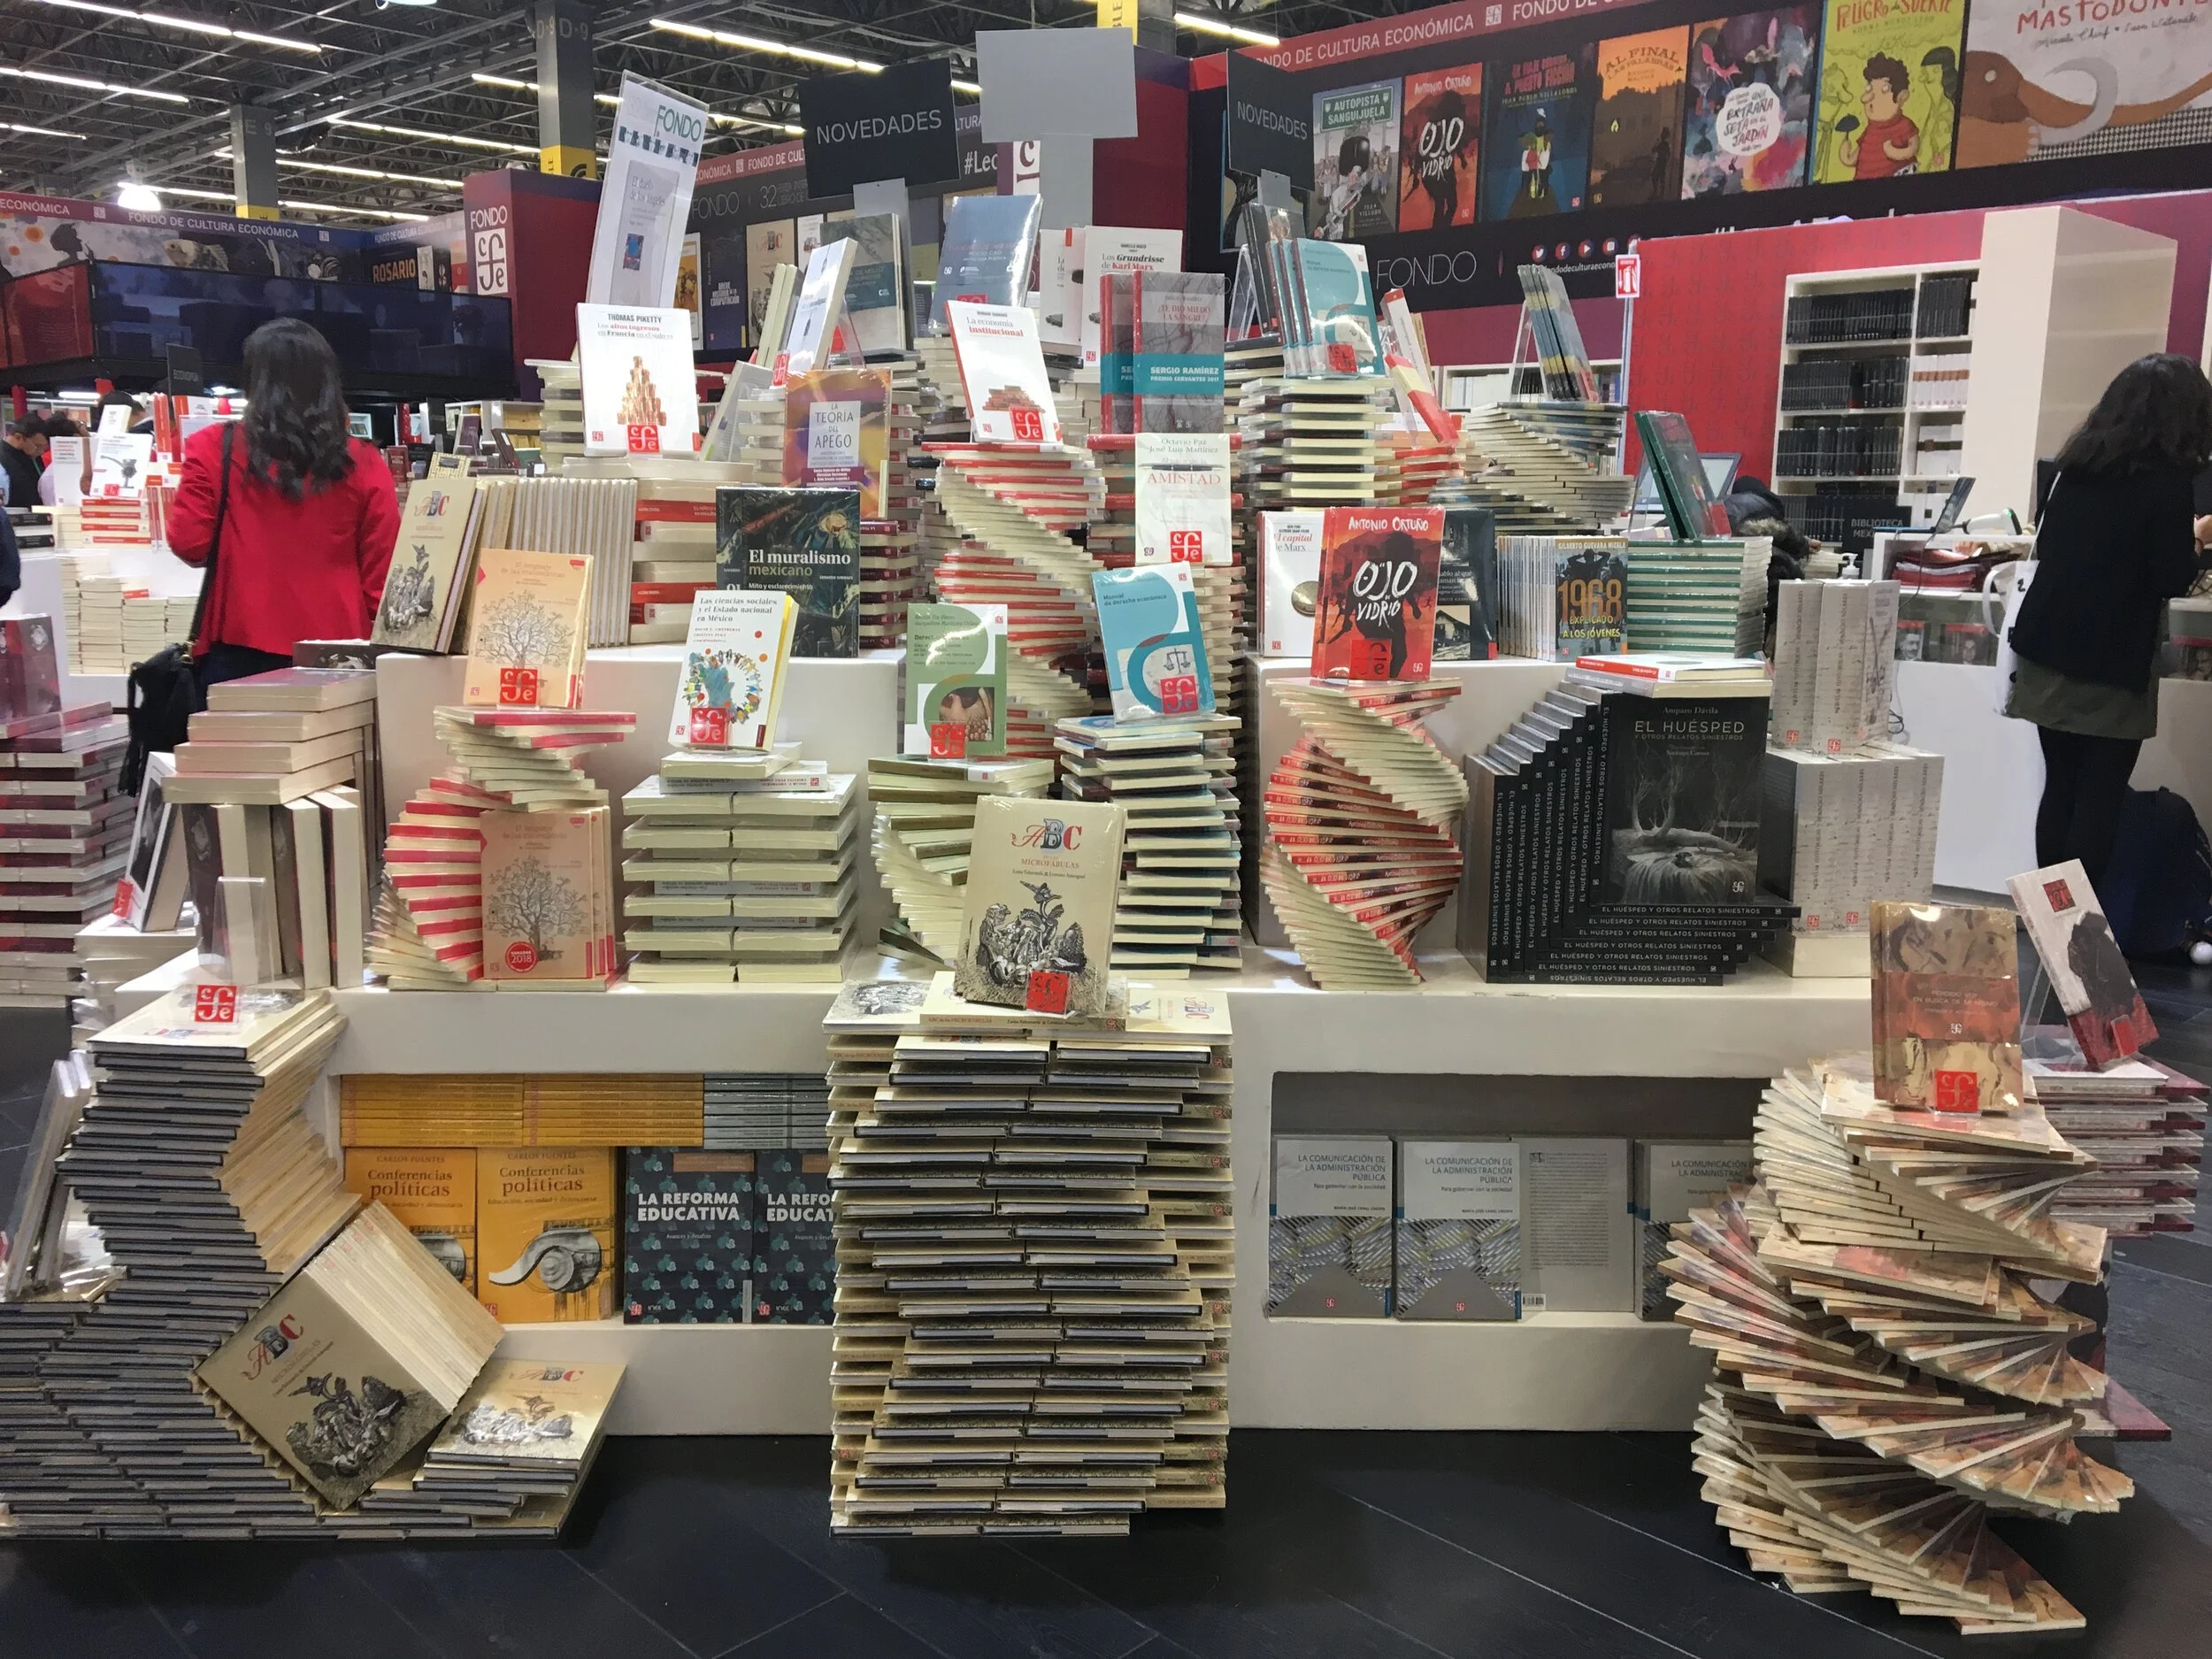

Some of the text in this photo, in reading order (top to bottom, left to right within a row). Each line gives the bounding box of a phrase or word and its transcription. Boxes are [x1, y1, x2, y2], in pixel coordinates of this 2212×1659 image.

[1295, 12, 1475, 65] DE CULTURA ECONÓMICA
[1629, 45, 1680, 65] FINAL
[1333, 94, 1380, 111] AUTOPISTA
[653, 104, 703, 142] FONDO
[1237, 100, 1308, 141] NOVEDADES
[1327, 105, 1386, 126] SANGUIJUELA
[815, 109, 942, 145] NOVEDADES
[1418, 116, 1464, 158] OJO
[748, 153, 787, 171] FONDO DE
[1422, 154, 1453, 182] VIDRIO
[0, 199, 71, 216] ECONÓMICA
[691, 190, 741, 219] FONDO
[759, 183, 779, 209] 32
[470, 204, 508, 230] FONDO
[127, 211, 299, 240] FONDO DE CULTURA ECONÓMICA
[1101, 253, 1165, 264] Los Grundrisse
[373, 257, 416, 284] ROSARIO
[1111, 262, 1131, 271] Karl
[1375, 250, 1477, 292] FONDO
[607, 312, 663, 325] THOMAS PIKETTY
[966, 316, 1014, 327] La economía
[607, 329, 636, 338] Francia
[610, 322, 628, 331] altos
[628, 323, 660, 332] ingresos
[969, 325, 1024, 337] institucional
[1150, 365, 1219, 375] SERGIO RAMÍREZ
[814, 409, 854, 424] TEORÍA
[814, 434, 852, 449] APEGO
[1161, 437, 1192, 446] Octavio
[1147, 472, 1222, 486] AMISTAD
[1348, 515, 1430, 533] ANTONIO ORTUÑO
[1282, 534, 1314, 544] capital
[1284, 543, 1307, 553] Marx
[749, 549, 851, 565] El muralismo
[748, 563, 813, 576] mexicano
[767, 581, 814, 590] esclarecimiento
[1352, 560, 1418, 602] OJO
[714, 596, 745, 605] ciencias
[1557, 578, 1622, 624] 1968
[740, 605, 772, 614] nacional
[1356, 599, 1402, 628] VIDRIO
[1569, 615, 1614, 626] EXPLICADO
[1563, 626, 1621, 639] A LOS JÓVENES
[1602, 707, 1609, 718] EL
[1662, 706, 1719, 717] Amparo Dávila
[1634, 718, 1745, 734] EL HUÉSPED
[1601, 718, 1609, 753] HUÉSPED
[1596, 787, 1605, 822] RELATOS
[1010, 818, 1082, 850] ABC
[1594, 822, 1602, 865] SINIESTROS
[1600, 917, 1634, 926] HUÉSPED
[511, 954, 533, 964] 2018
[506, 1152, 539, 1161] CARLOS
[1309, 1153, 1374, 1164] COMUNICACIÓN
[1435, 1156, 1501, 1166] COMUNICACIÓN
[1502, 1157, 1513, 1166] DE
[367, 1169, 453, 1181] Conferencias
[499, 1164, 585, 1179] Conferencias
[1316, 1163, 1386, 1172] ADMINISTRACIÓN
[1442, 1165, 1513, 1175] ADMINISTRACIÓN
[1352, 1171, 1386, 1181] PÚBLICA
[1479, 1173, 1512, 1184] PÚBLICA
[370, 1180, 451, 1200] políticas
[502, 1177, 584, 1197] políticas
[637, 1192, 740, 1206] LA REFORMA
[766, 1193, 787, 1206] LA
[637, 1207, 741, 1222] EDUCATIVA
[240, 1313, 303, 1380] ABC
